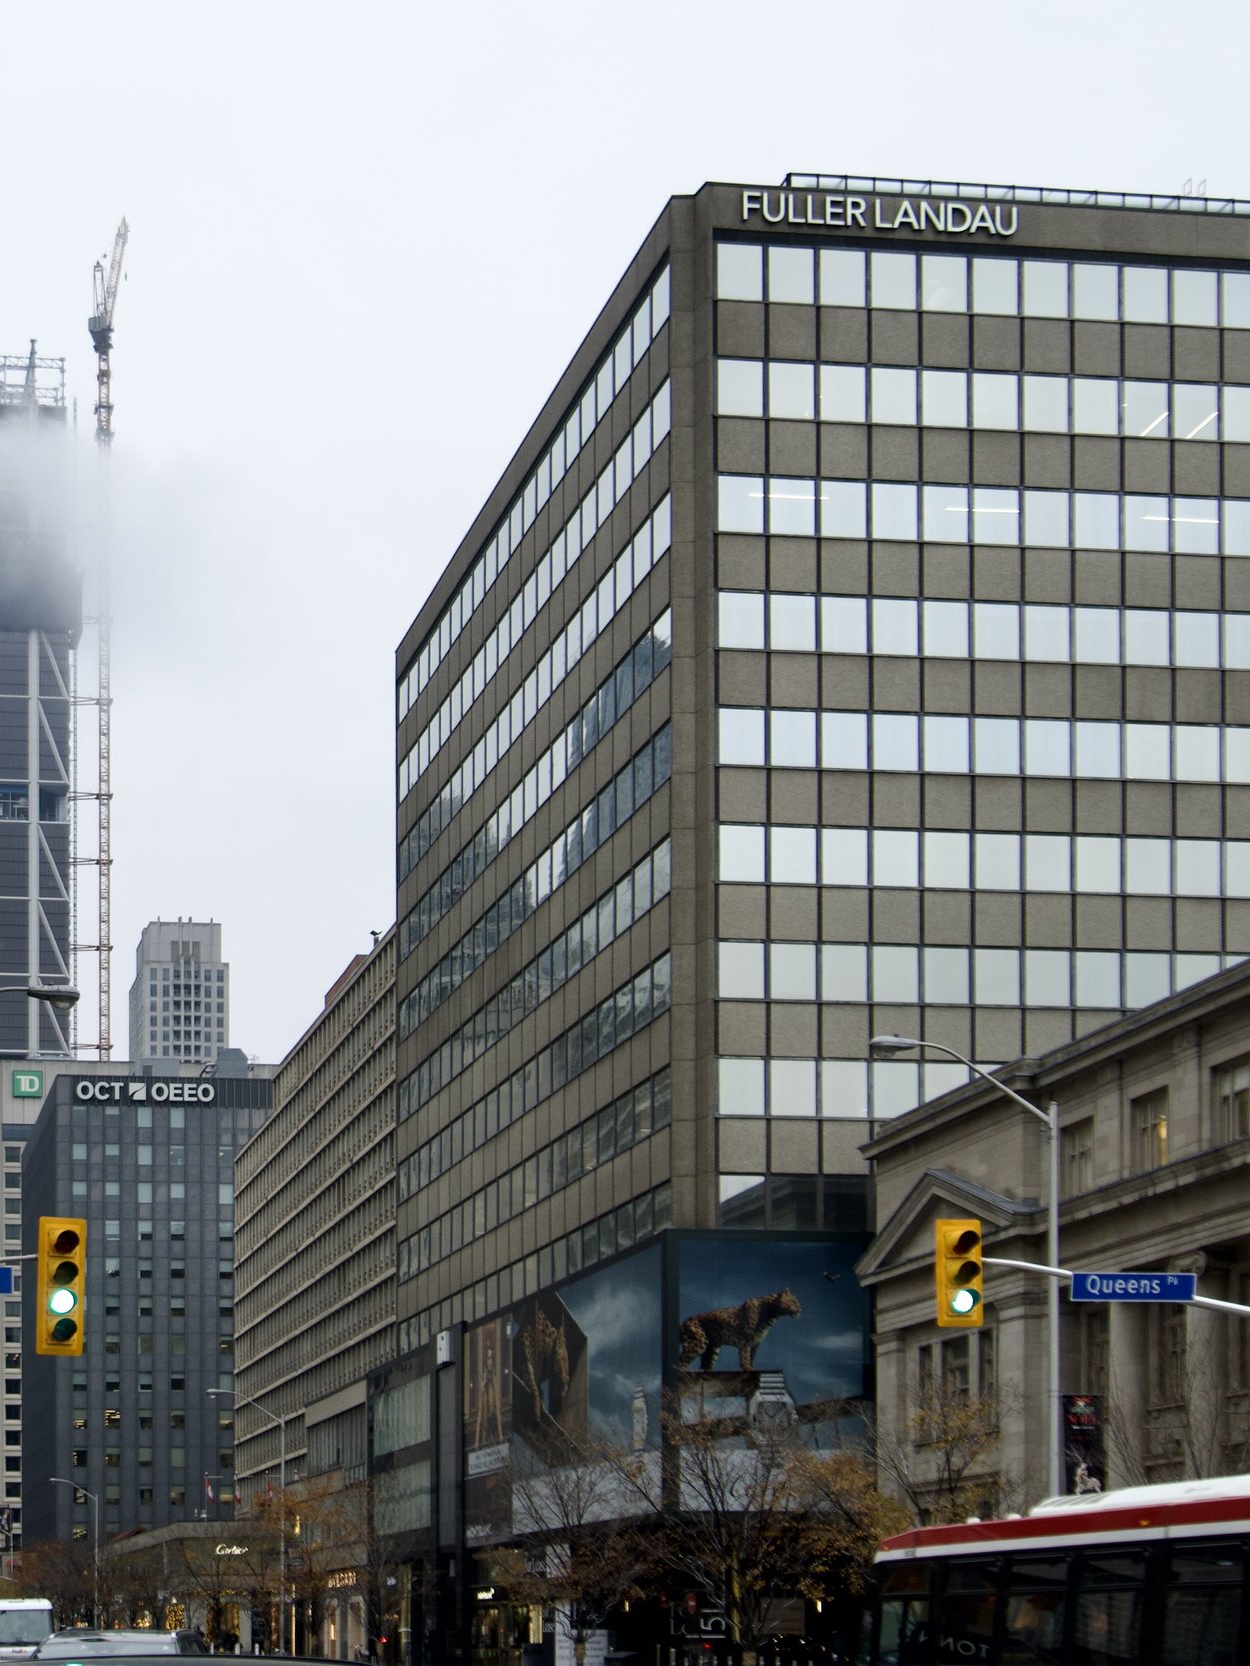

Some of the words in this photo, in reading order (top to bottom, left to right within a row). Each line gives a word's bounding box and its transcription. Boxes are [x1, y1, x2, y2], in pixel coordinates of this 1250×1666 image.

[742, 190, 867, 228] FULLER
[874, 199, 1019, 236] LANDAU
[16, 1075, 40, 1092] TD
[76, 1081, 124, 1101] OCT
[151, 1083, 215, 1103] OEEO
[1086, 1275, 1161, 1296] Queens
[1167, 1276, 1180, 1286] Pk
[215, 1543, 248, 1555] Cartier
